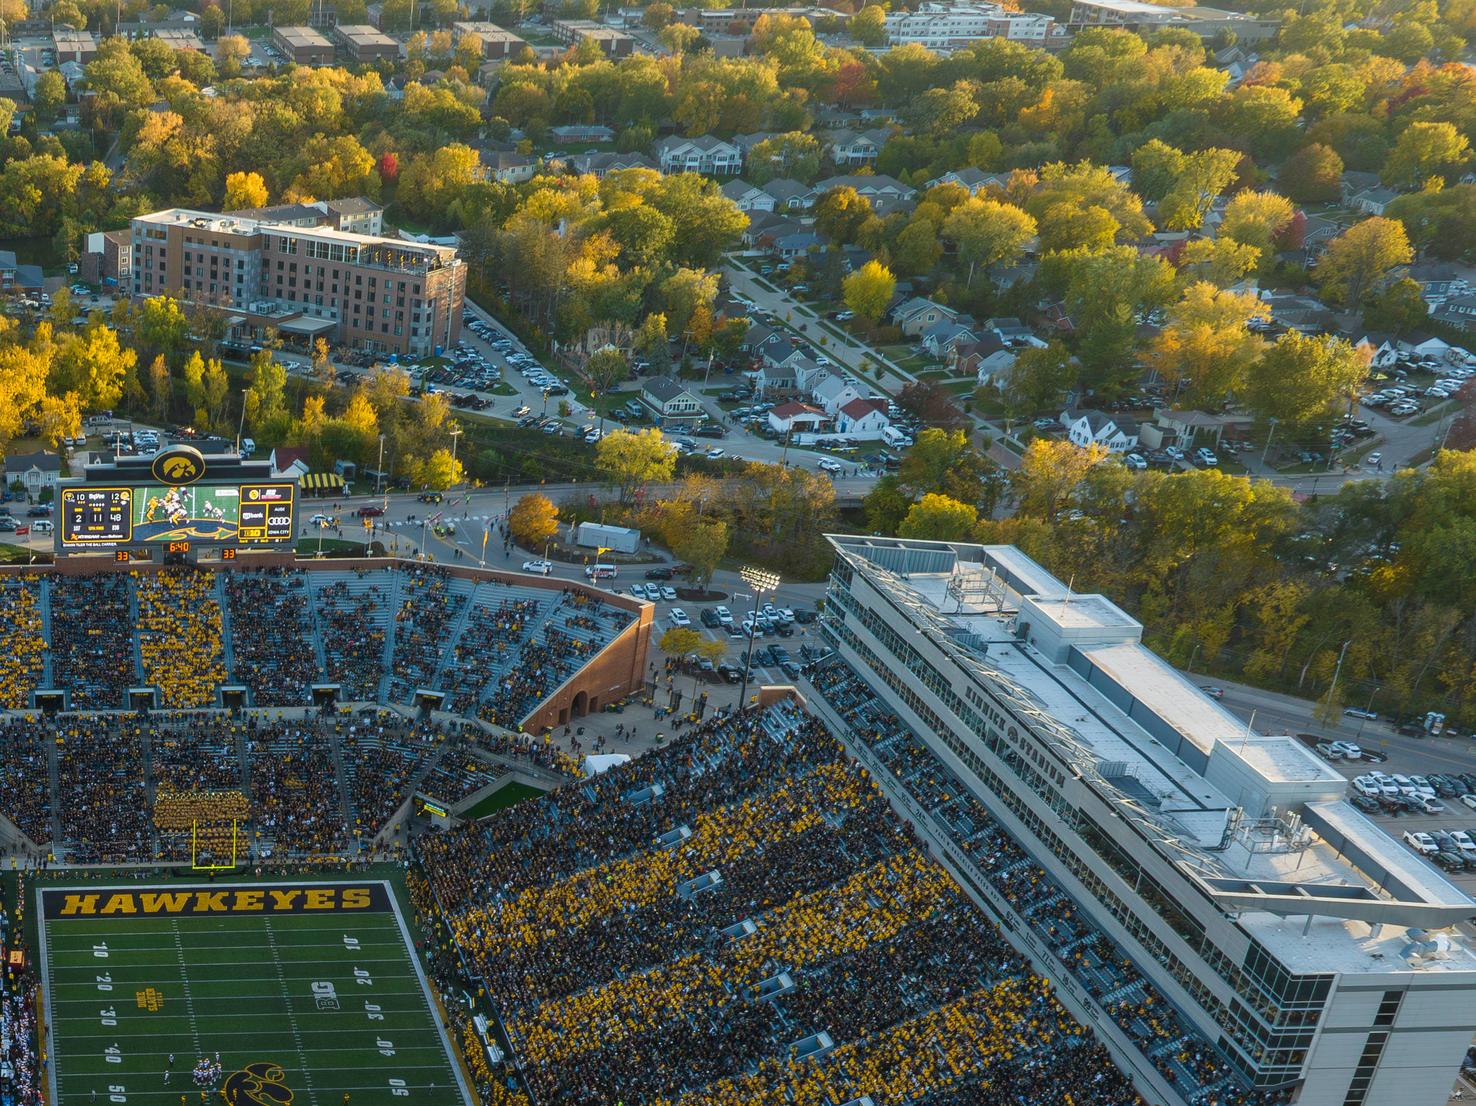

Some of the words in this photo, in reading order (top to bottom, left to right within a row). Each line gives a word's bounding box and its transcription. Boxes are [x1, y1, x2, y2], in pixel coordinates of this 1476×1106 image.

[94, 514, 102, 522] 11
[170, 542, 188, 552] 6:40
[223, 550, 234, 559] 33
[117, 552, 128, 561] 33
[964, 686, 1006, 731] KINNICK
[1019, 737, 1066, 788] STADIUM
[60, 889, 370, 914] HAWKEYES
[93, 945, 108, 958] 10
[343, 938, 361, 950] 10
[96, 976, 113, 991] 20
[354, 970, 372, 986] 20
[136, 992, 147, 1008] DUKE
[146, 988, 158, 1012] SLATER
[100, 1010, 117, 1026] 30
[365, 1004, 384, 1020] 30
[105, 1047, 121, 1063] 40
[376, 1040, 395, 1056] 40
[109, 1085, 126, 1102] 50
[388, 1079, 409, 1096] 50
